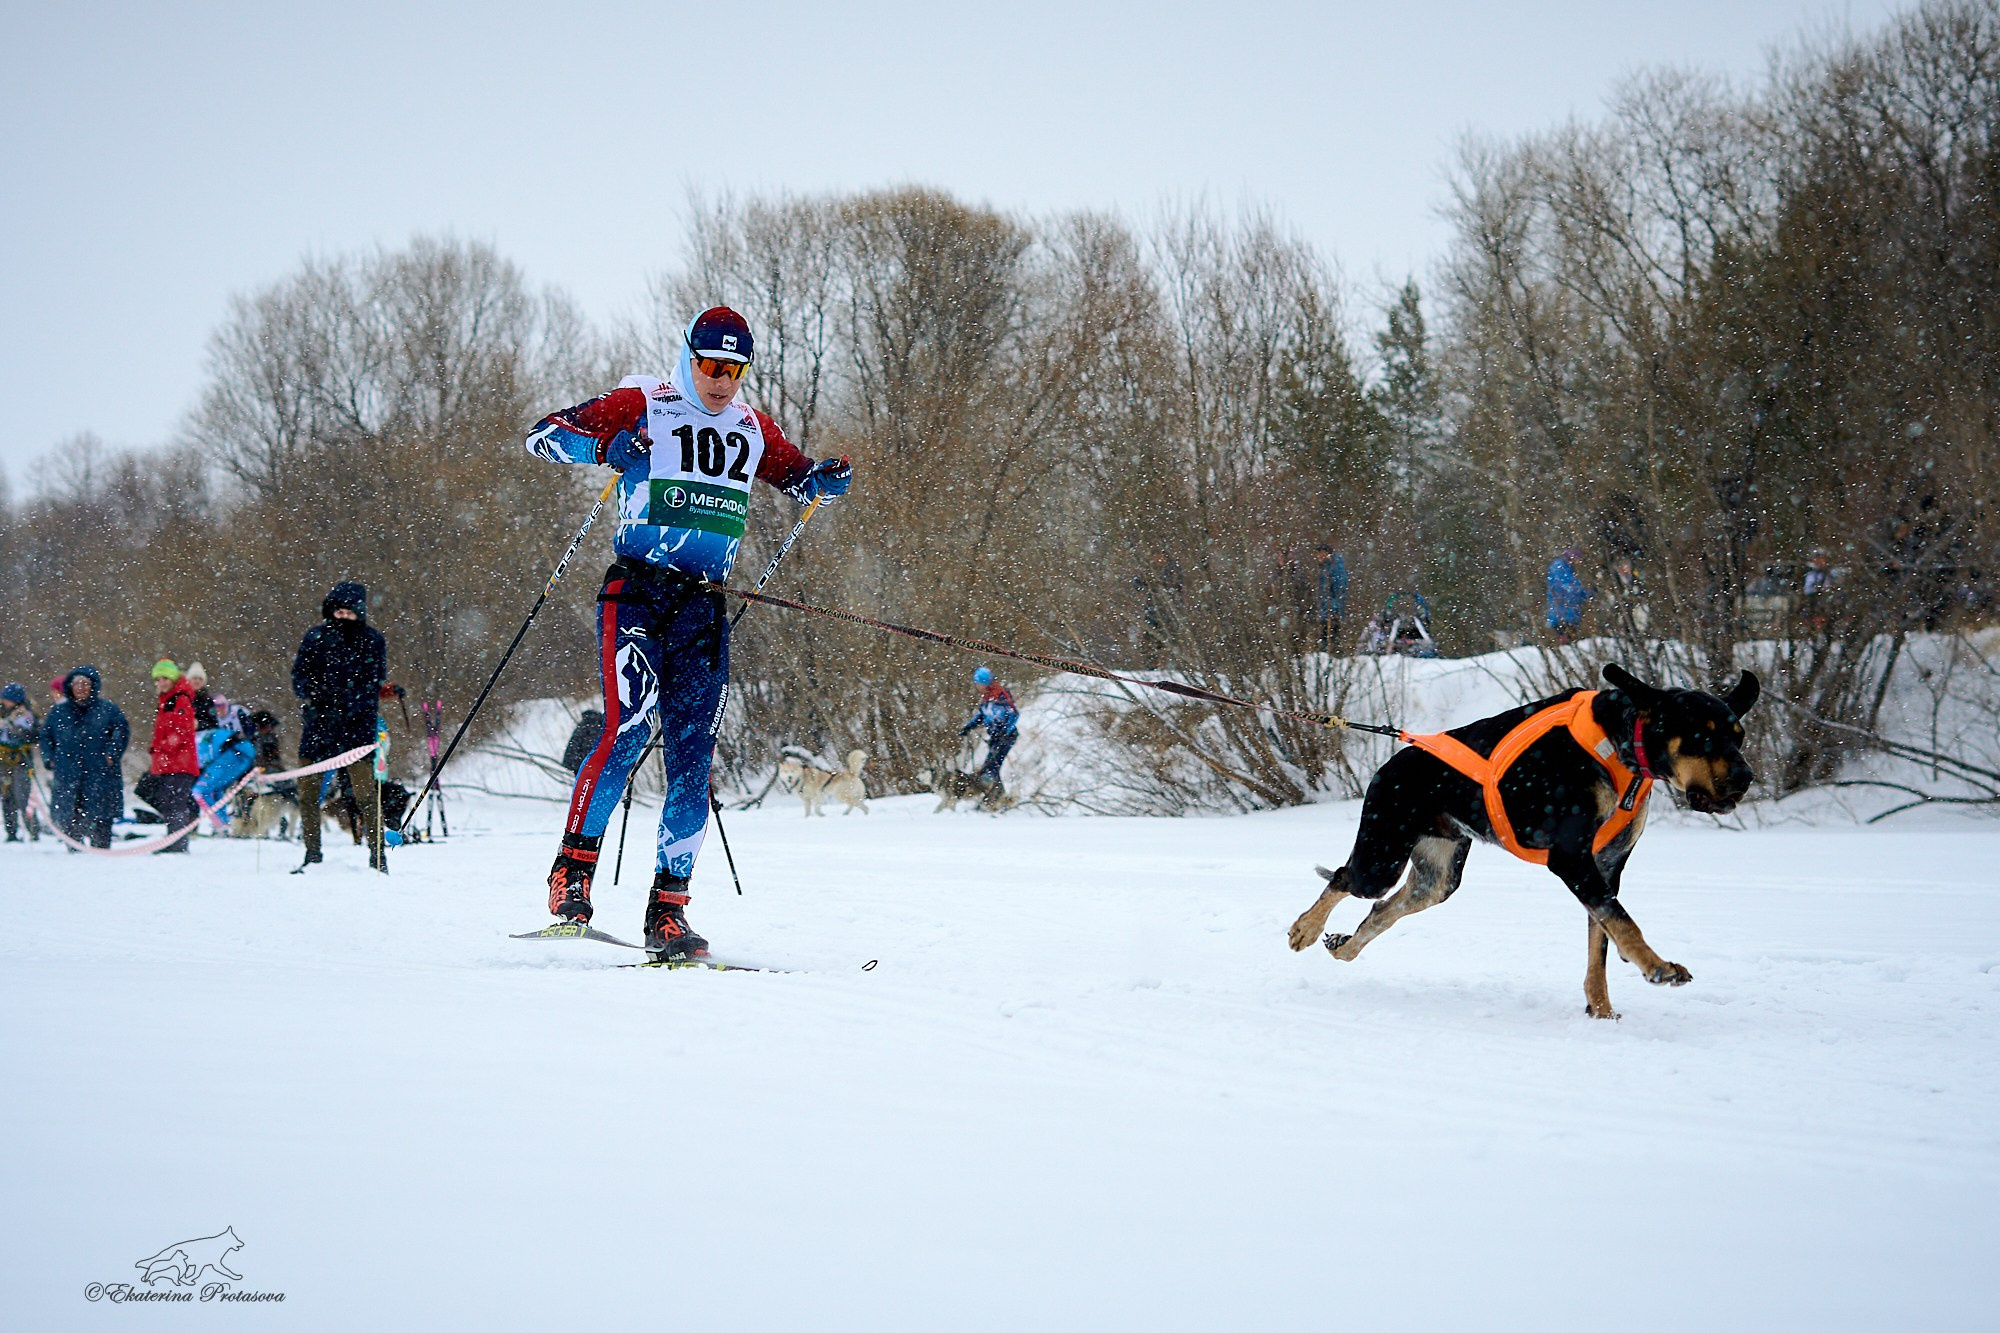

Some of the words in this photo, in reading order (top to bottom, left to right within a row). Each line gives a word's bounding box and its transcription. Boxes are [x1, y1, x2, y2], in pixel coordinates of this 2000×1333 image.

[631, 437, 647, 454] LEKI
[672, 424, 749, 484] 102
[709, 683, 729, 736] ФЕДЕРАЦИЯ
[577, 778, 592, 813] VICTORY
[540, 925, 578, 937] FISCHER
